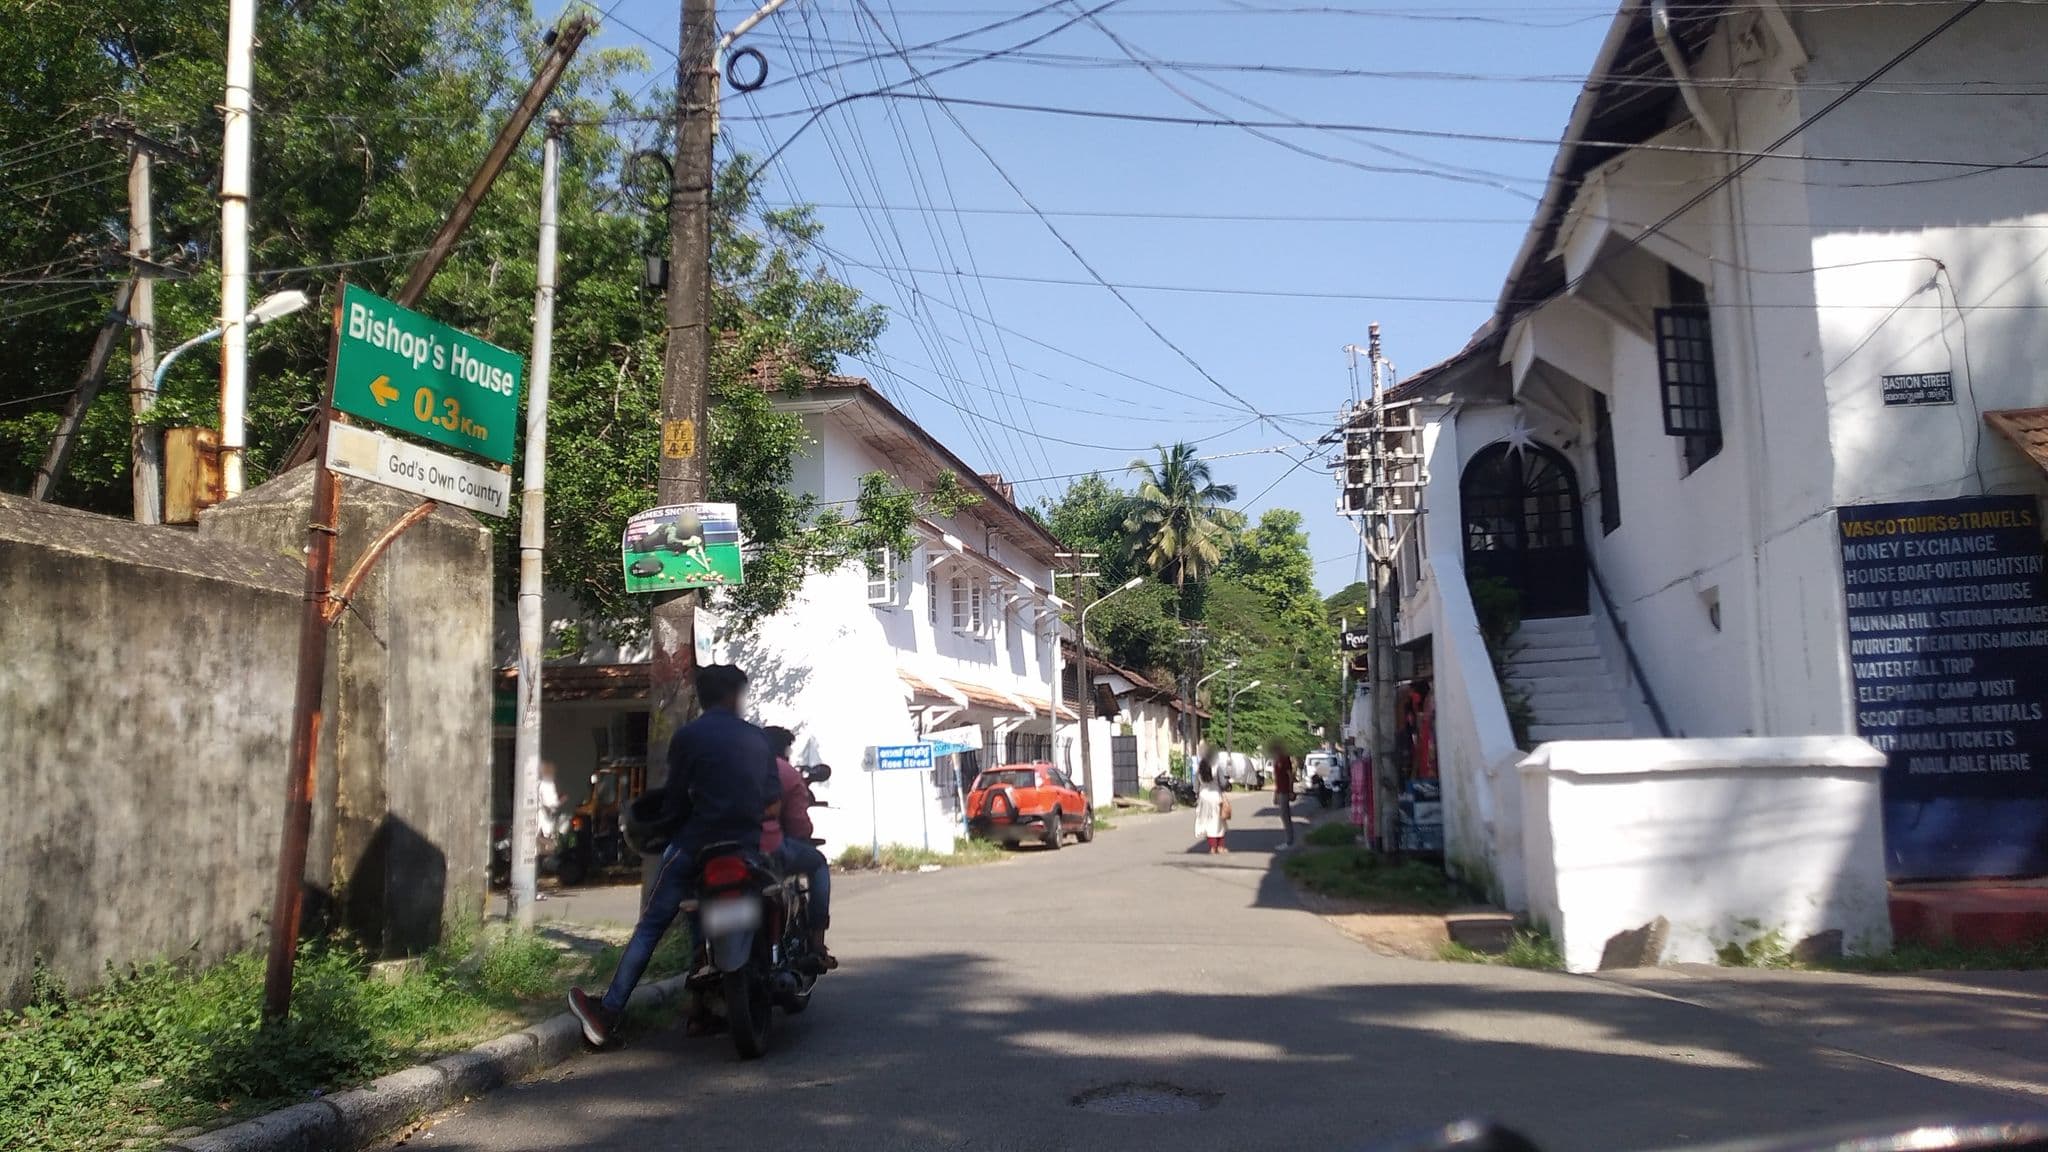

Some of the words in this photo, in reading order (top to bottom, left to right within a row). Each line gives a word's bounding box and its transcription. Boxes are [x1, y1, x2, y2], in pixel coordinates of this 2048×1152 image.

[348, 302, 445, 370] Bishop's
[451, 343, 514, 396] House
[1882, 376, 1920, 390] BASTION
[1922, 374, 1950, 388] STREET
[388, 455, 425, 482] God's
[428, 466, 454, 490] Own
[458, 476, 502, 507] Country
[1843, 520, 1896, 538] VASCO
[1899, 515, 1947, 534] TOURS
[1960, 510, 2033, 529] TRAVELS
[1843, 541, 1900, 561] MONEY
[1904, 535, 1997, 557] EXCHANGE
[1846, 567, 1897, 585] HOUSE
[1847, 591, 1889, 609] DAILY
[1892, 585, 1982, 605] BACKWATER
[1982, 582, 2032, 601] CRUISE
[1849, 614, 1907, 632] MUNNAR
[1851, 636, 1913, 656] AYURVEDIC
[1853, 661, 1904, 679] WATER
[1942, 657, 1975, 675] TRIP
[1859, 683, 1935, 703] ELEPHANT
[1937, 681, 1978, 700] CAMP
[1980, 679, 2016, 697] VISIT
[1971, 703, 2042, 723] RENTALS
[1868, 732, 1947, 751] ATHAKALI
[1948, 730, 2016, 748] TICKETS
[1910, 755, 1986, 774] AVAILABLE
[1989, 754, 2030, 770] HERE
